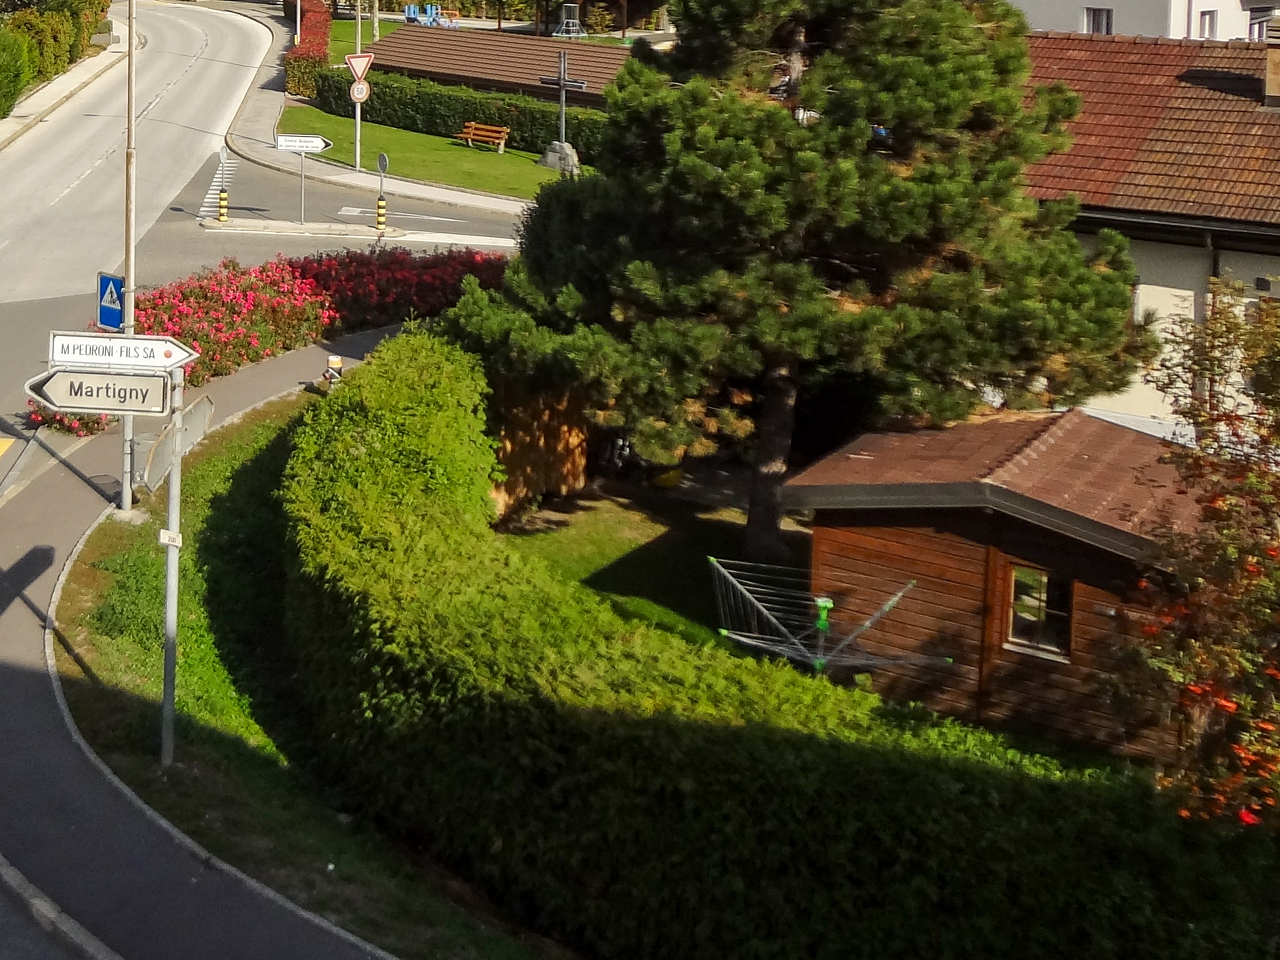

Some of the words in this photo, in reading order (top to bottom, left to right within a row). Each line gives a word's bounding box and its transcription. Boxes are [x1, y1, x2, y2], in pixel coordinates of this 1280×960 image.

[61, 343, 70, 355] M
[72, 344, 114, 357] PEDRONI
[119, 345, 140, 359] FILS
[143, 346, 156, 359] SA
[69, 380, 149, 403] Martigny
